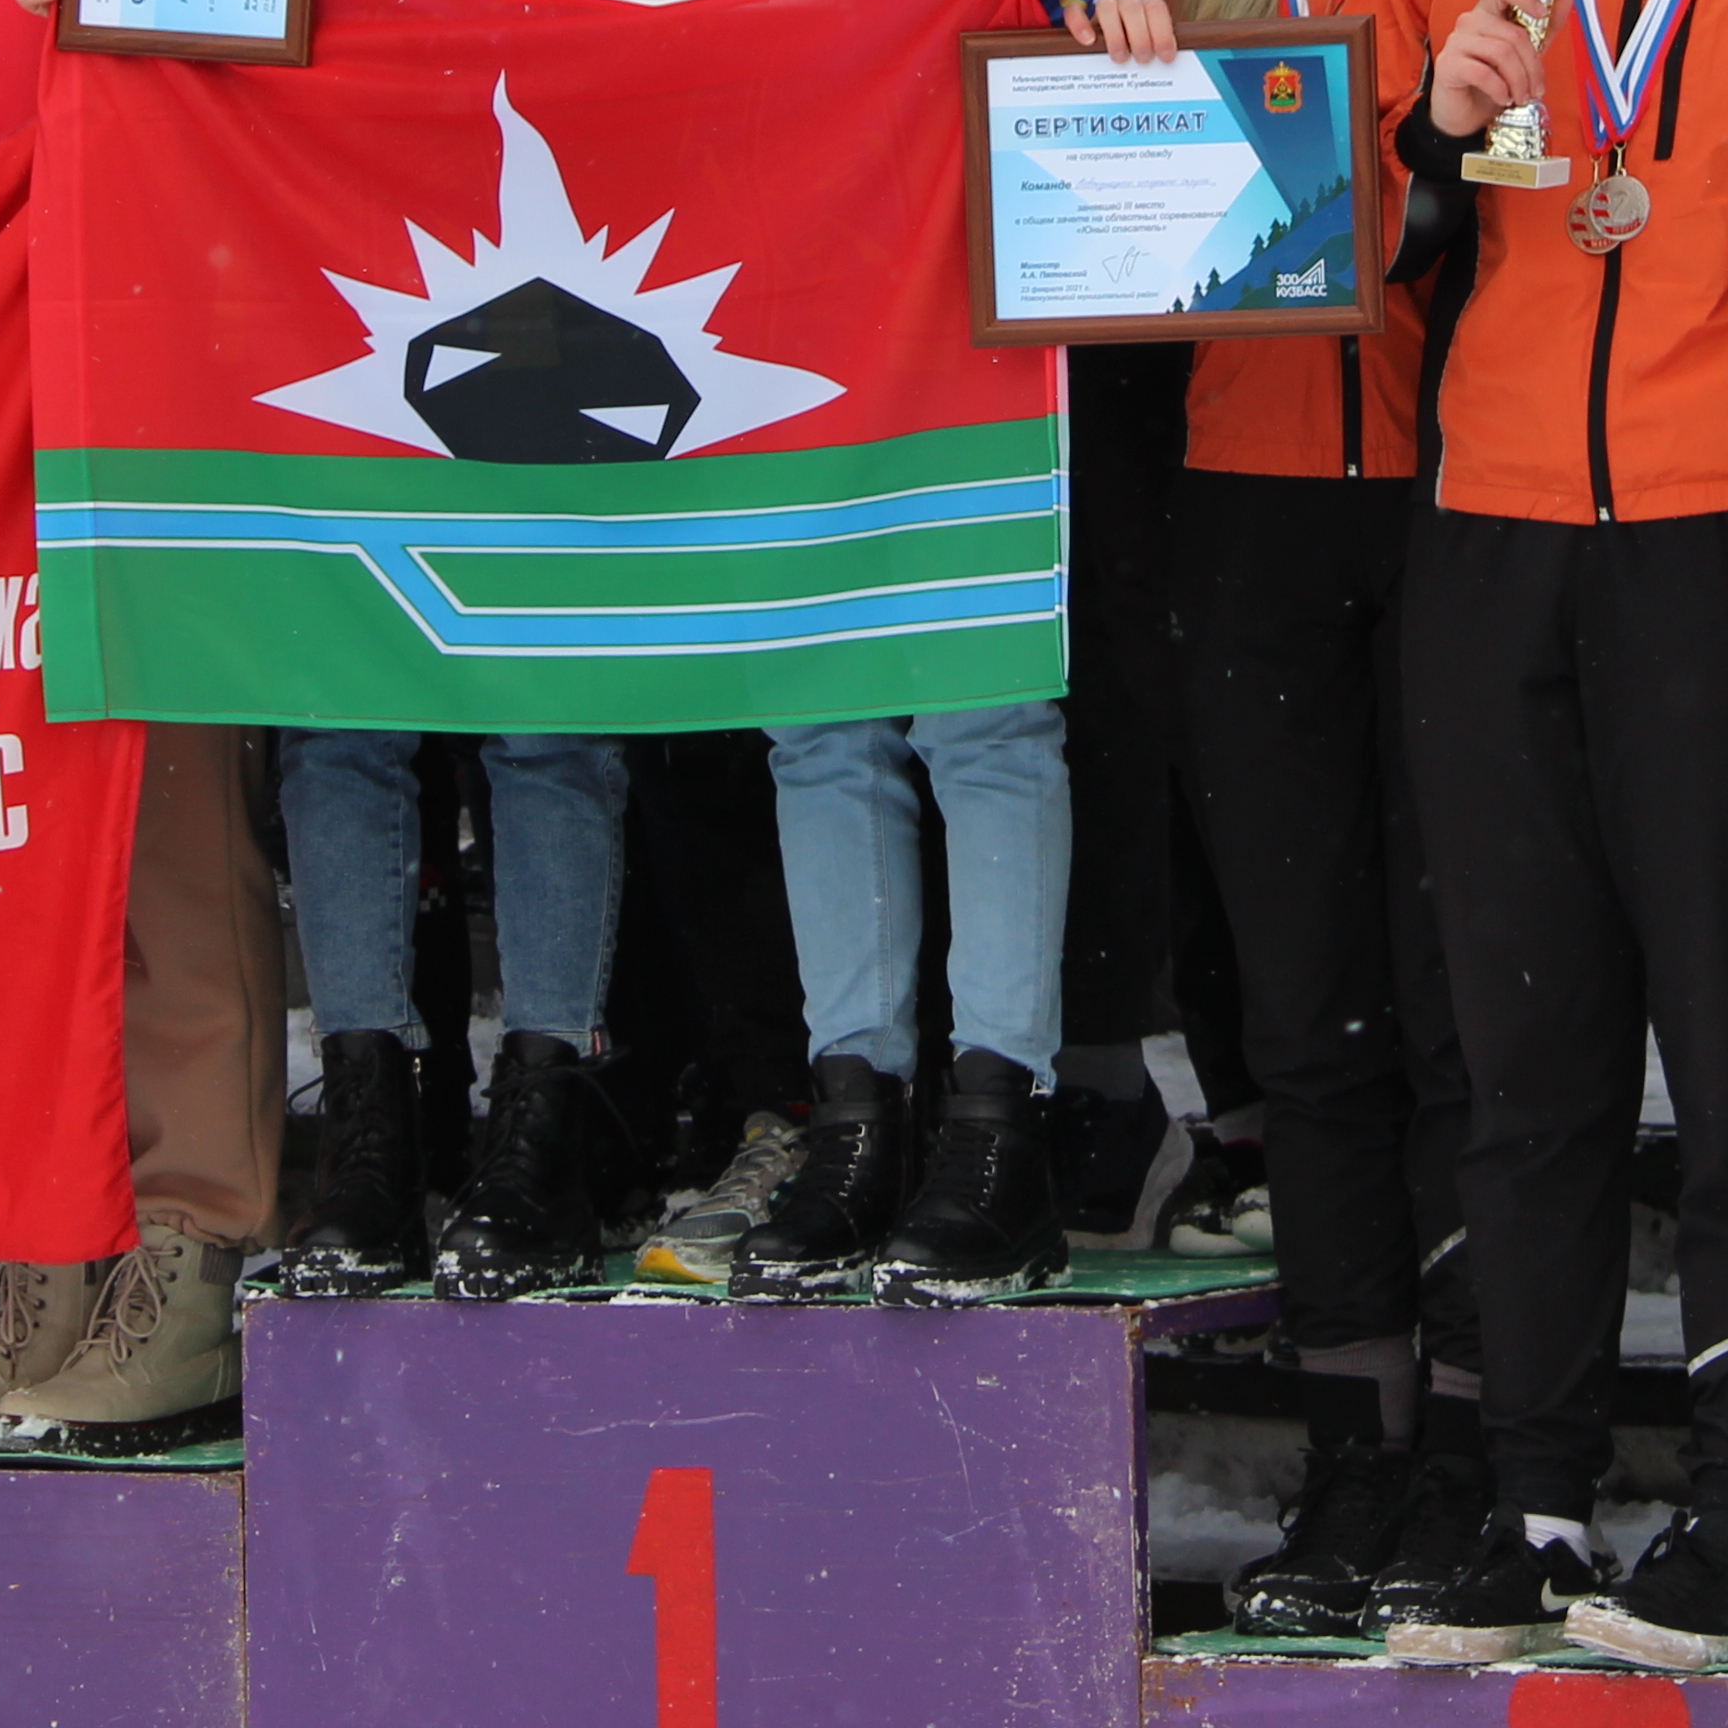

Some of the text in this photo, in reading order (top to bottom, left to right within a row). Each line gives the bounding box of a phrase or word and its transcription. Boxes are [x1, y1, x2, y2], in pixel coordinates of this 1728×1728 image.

[1014, 111, 1207, 138] СЕРТИФИКАТ
[1021, 181, 1072, 191] Команде
[625, 1467, 718, 1728] 1
